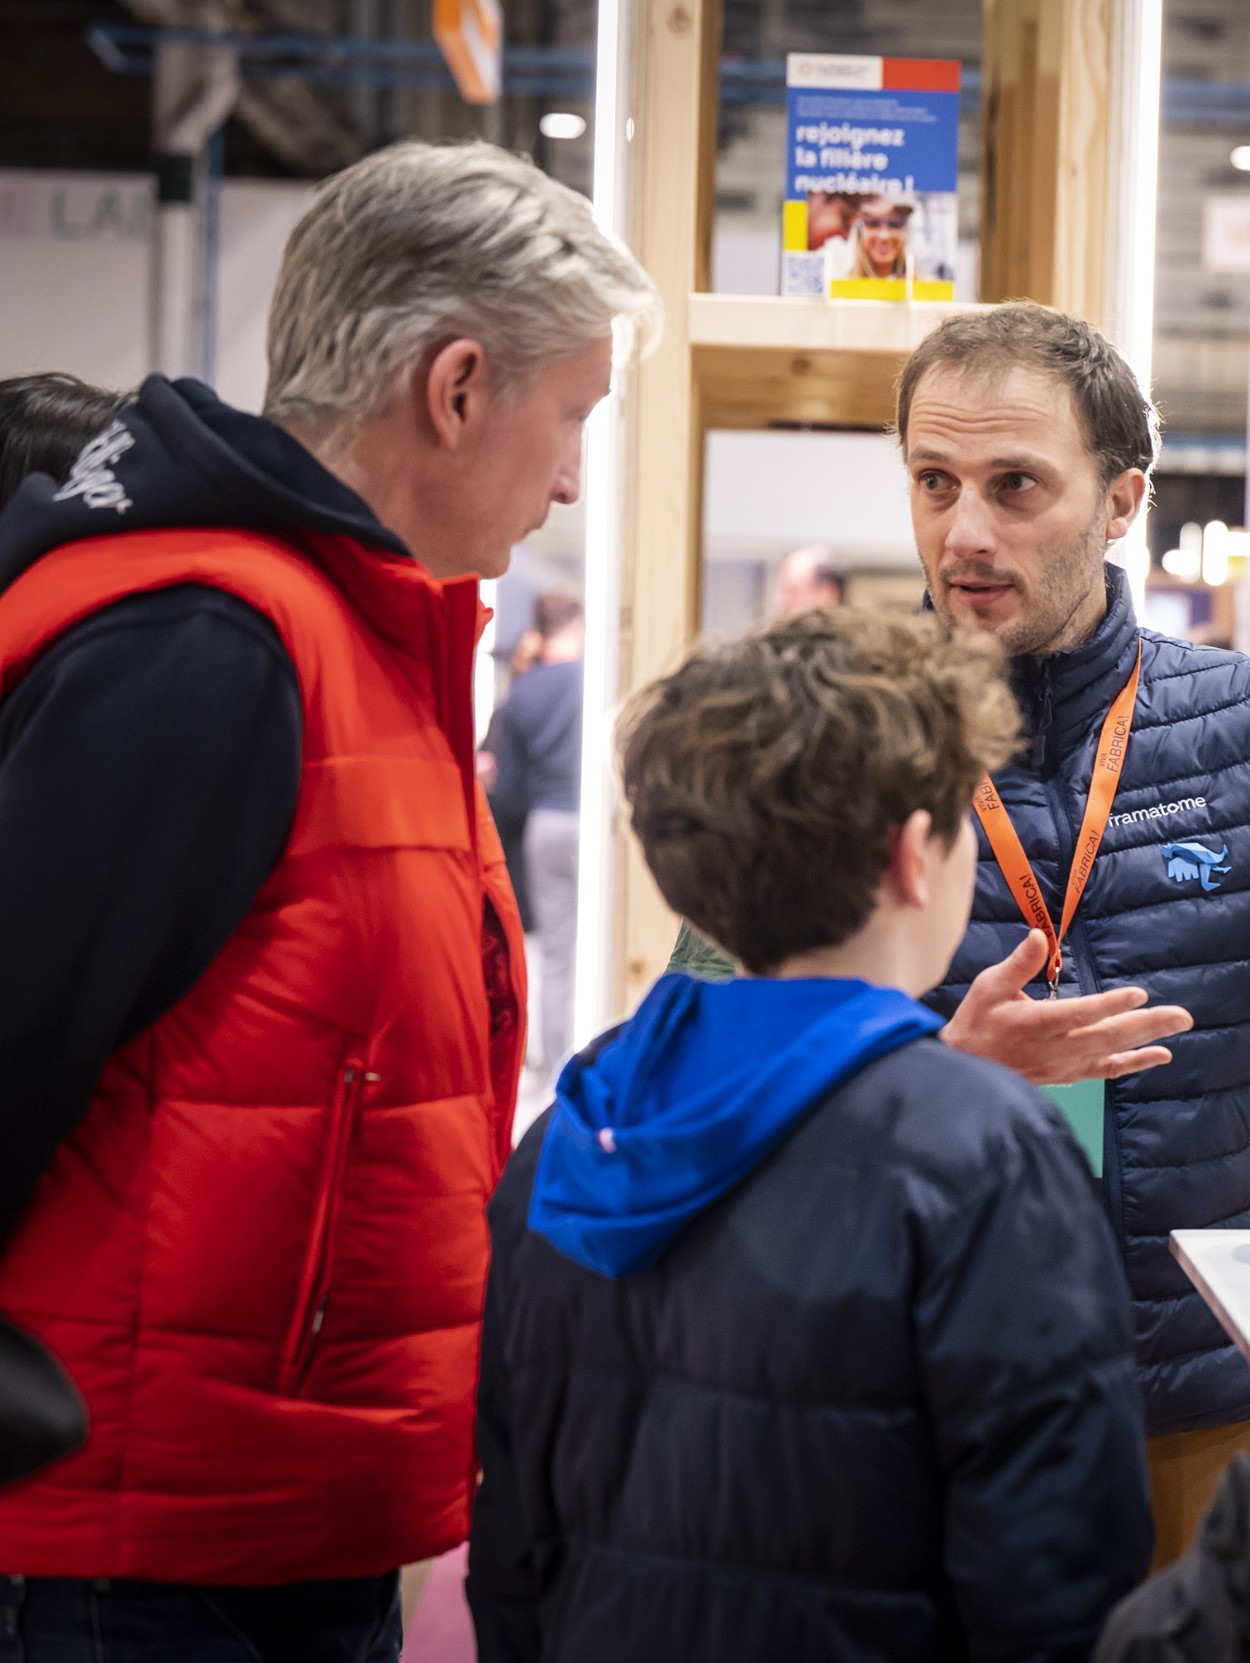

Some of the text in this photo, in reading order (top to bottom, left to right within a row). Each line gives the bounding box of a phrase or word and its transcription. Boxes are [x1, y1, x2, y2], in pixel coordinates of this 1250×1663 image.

[796, 121, 905, 149] rejoignez
[795, 146, 888, 171] la filière
[1107, 715, 1130, 773] FABRICA!
[1074, 829, 1101, 895] FABRICA!
